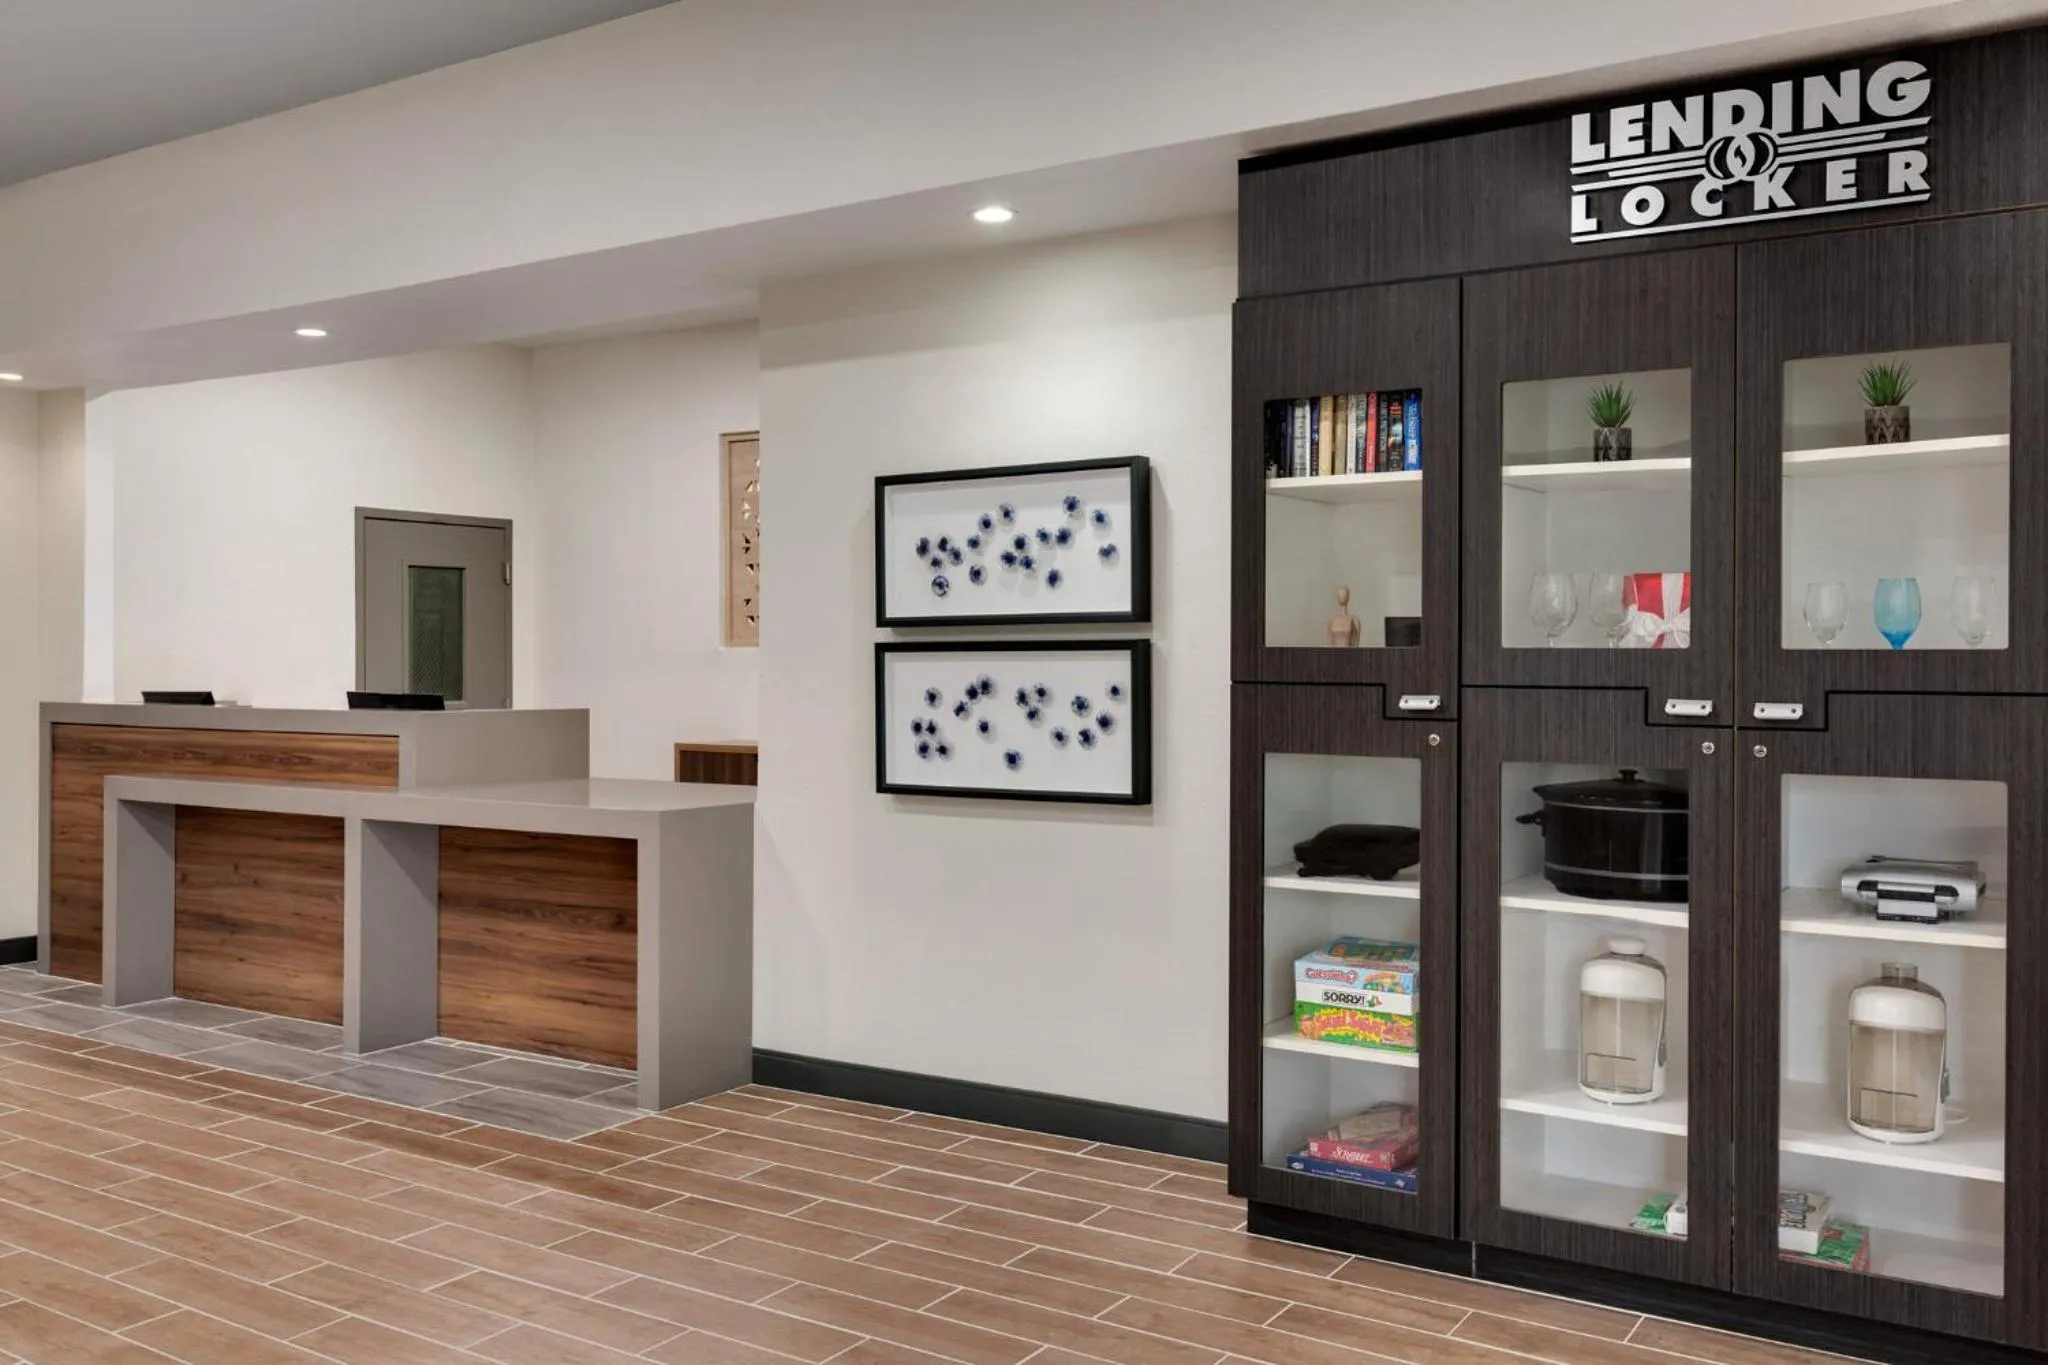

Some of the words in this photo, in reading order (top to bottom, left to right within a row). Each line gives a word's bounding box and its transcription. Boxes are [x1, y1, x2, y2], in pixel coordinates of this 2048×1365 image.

[1571, 60, 1932, 164] LENDING
[1571, 149, 1931, 234] LOCKER
[1323, 991, 1365, 1006] SORRY!
